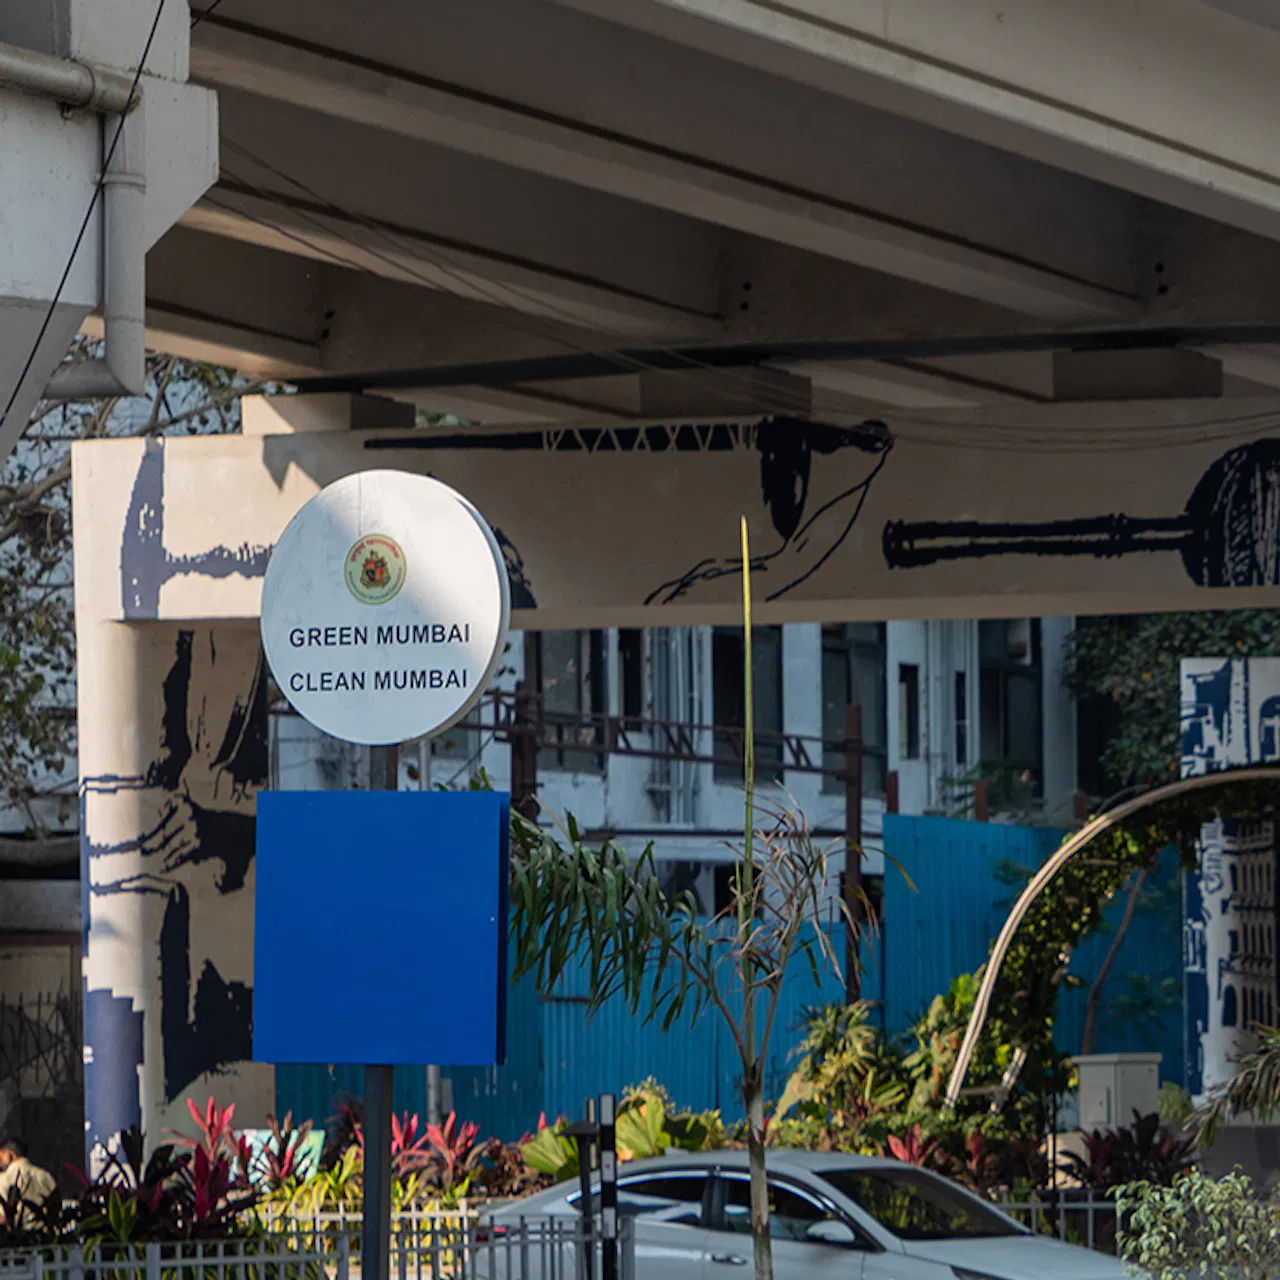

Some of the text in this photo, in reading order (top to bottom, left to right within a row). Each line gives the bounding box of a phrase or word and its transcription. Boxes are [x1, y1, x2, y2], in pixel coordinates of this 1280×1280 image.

[289, 623, 470, 648] GREEN MUMBAI
[289, 669, 468, 692] CLEAN MUMBAI
